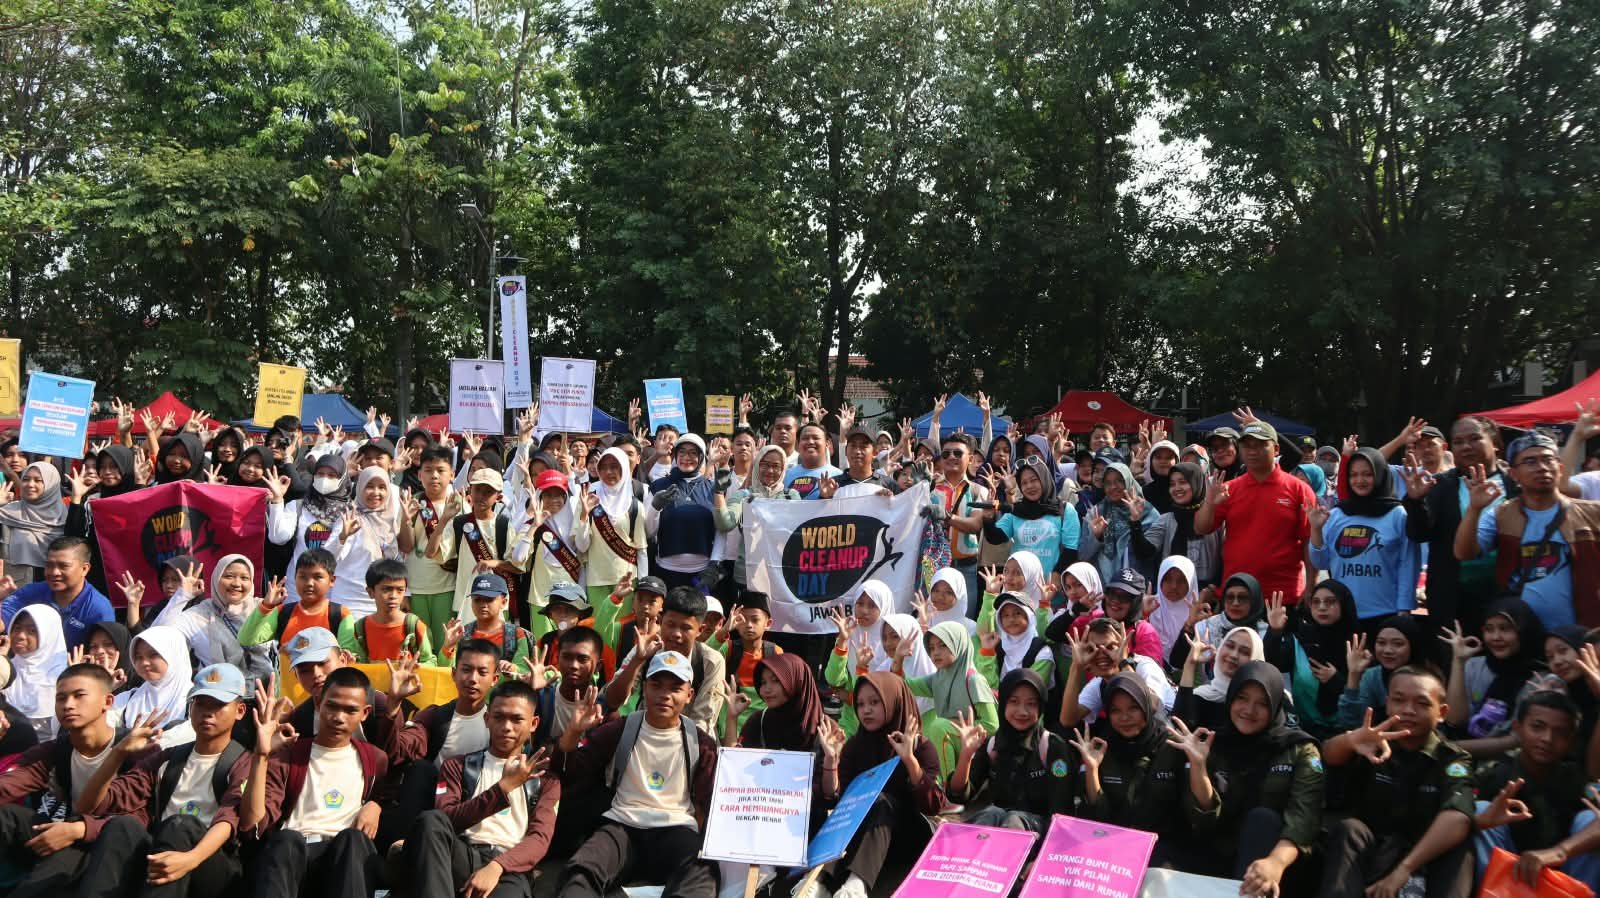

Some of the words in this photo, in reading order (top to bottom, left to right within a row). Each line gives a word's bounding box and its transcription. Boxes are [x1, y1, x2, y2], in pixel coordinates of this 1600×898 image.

[802, 524, 856, 548] WORLD
[799, 546, 868, 572] CLEANUP
[1342, 564, 1382, 578] JABAR
[798, 573, 829, 596] DAY
[720, 786, 746, 794] SAMPAH
[720, 804, 740, 813] CARA
[742, 804, 800, 816] MEMBUANGNYA
[1048, 853, 1084, 864] SAYANGI
[1086, 858, 1109, 870] BUMI
[958, 865, 989, 877] SAMPAH
[1064, 867, 1081, 876] YUK
[1084, 870, 1110, 884] PILAH
[1038, 874, 1072, 887] SAMPAH
[1073, 880, 1096, 891] DARI
